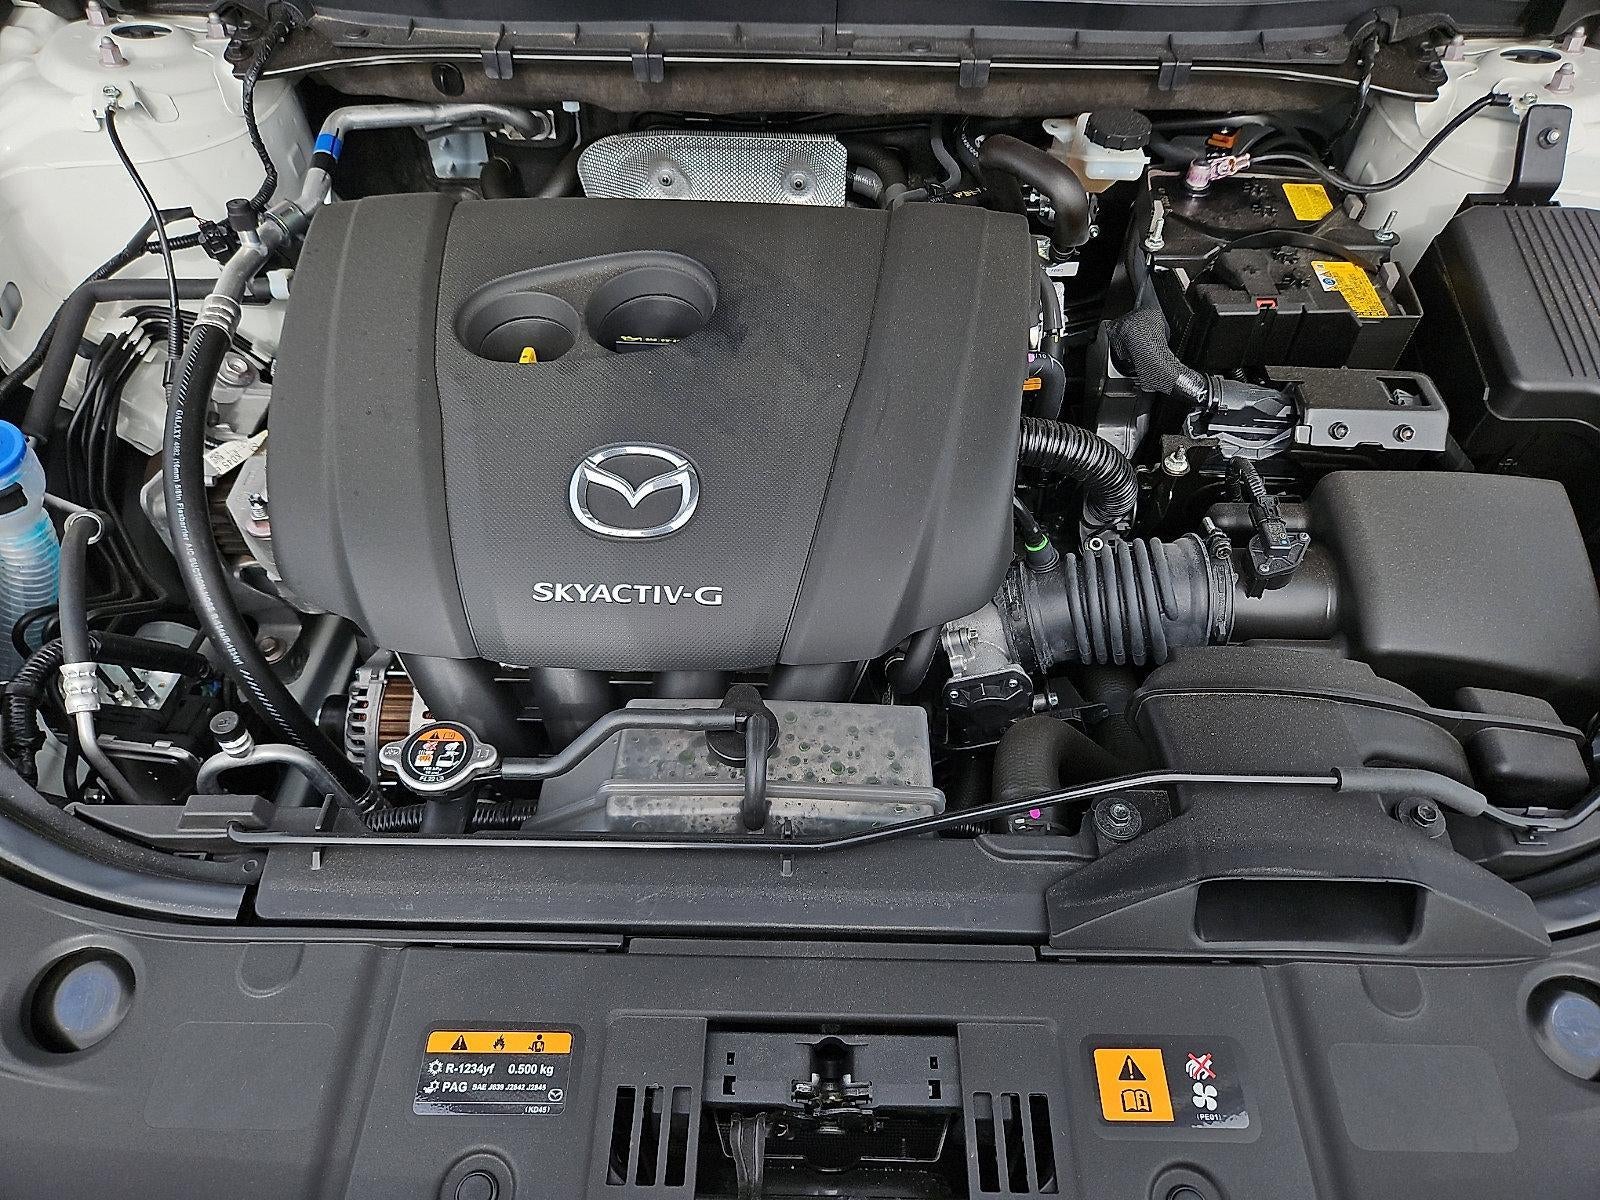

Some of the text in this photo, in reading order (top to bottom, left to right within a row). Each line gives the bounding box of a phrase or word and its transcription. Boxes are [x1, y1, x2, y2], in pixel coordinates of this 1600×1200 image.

[173, 409, 184, 440] GALAXY
[185, 542, 195, 556] A/C
[532, 582, 723, 606] SKYACTIV-G
[445, 1063, 554, 1077] R-1234yf 0.500 kg
[441, 1081, 468, 1093] PAG
[1196, 1113, 1222, 1121] (PE01)
